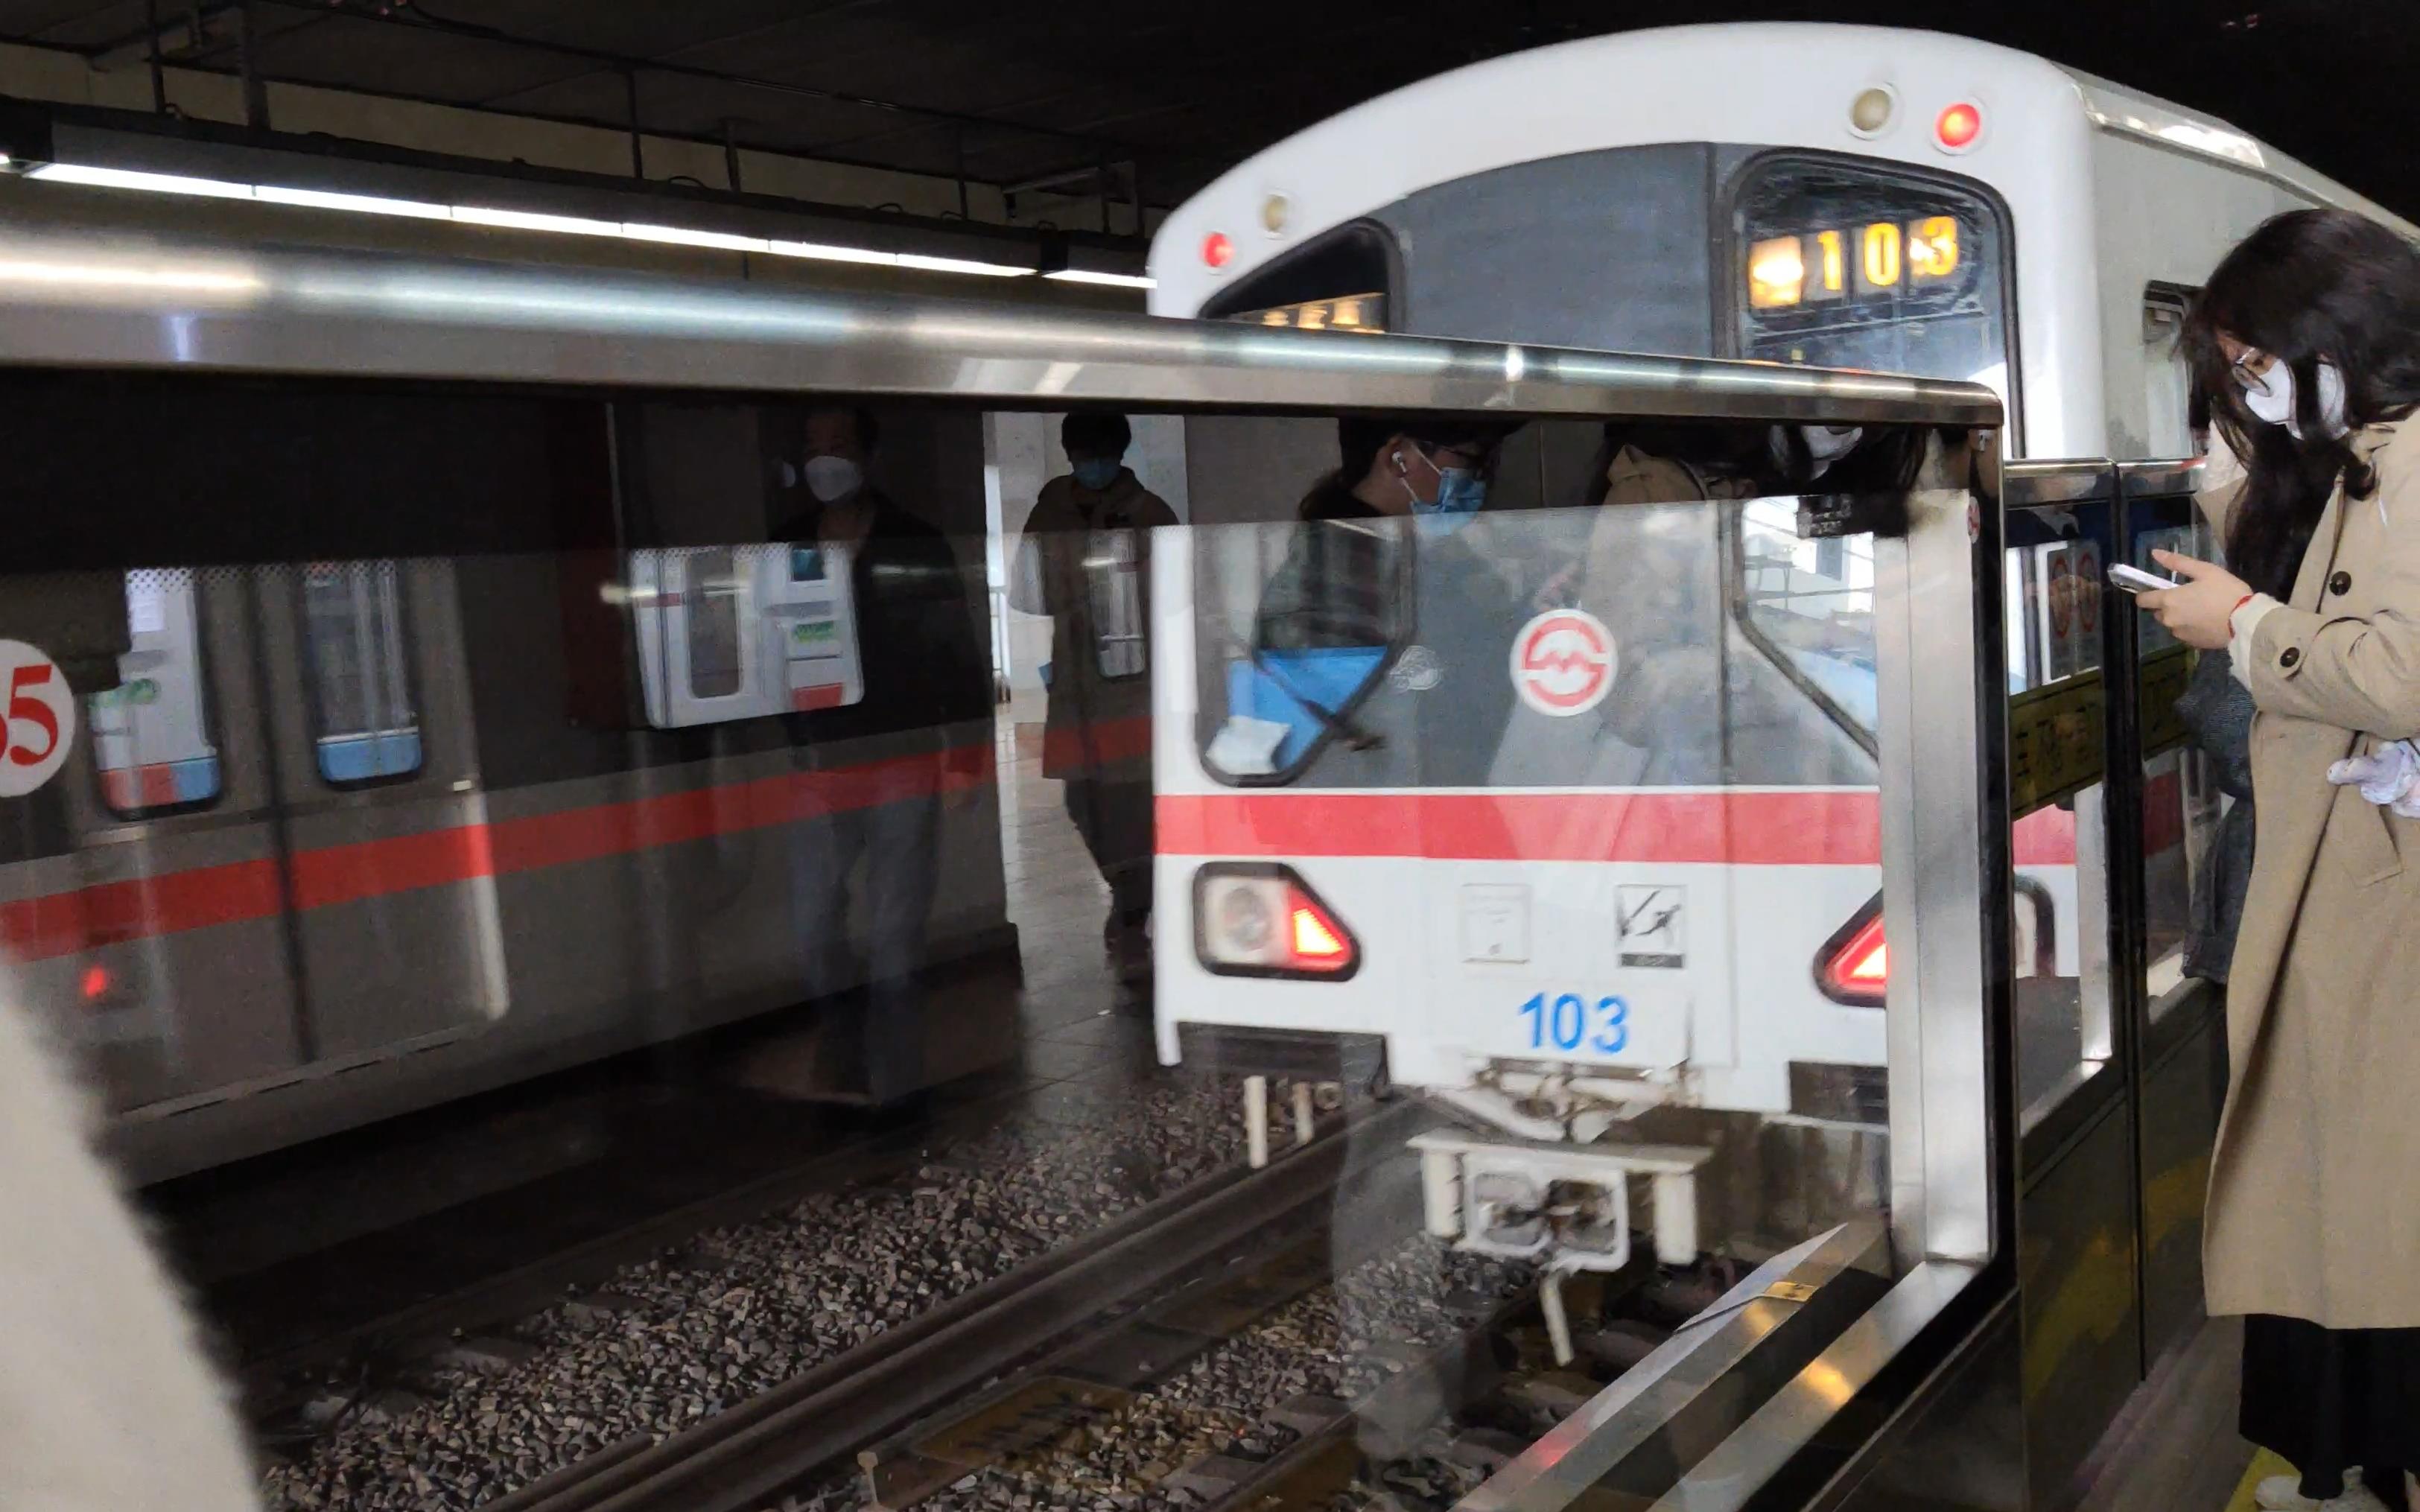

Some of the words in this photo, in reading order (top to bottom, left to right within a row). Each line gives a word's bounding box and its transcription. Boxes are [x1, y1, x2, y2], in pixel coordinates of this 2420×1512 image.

[1817, 215, 1958, 291] 103
[0, 664, 58, 766] 5
[1519, 992, 1628, 1054] 103
